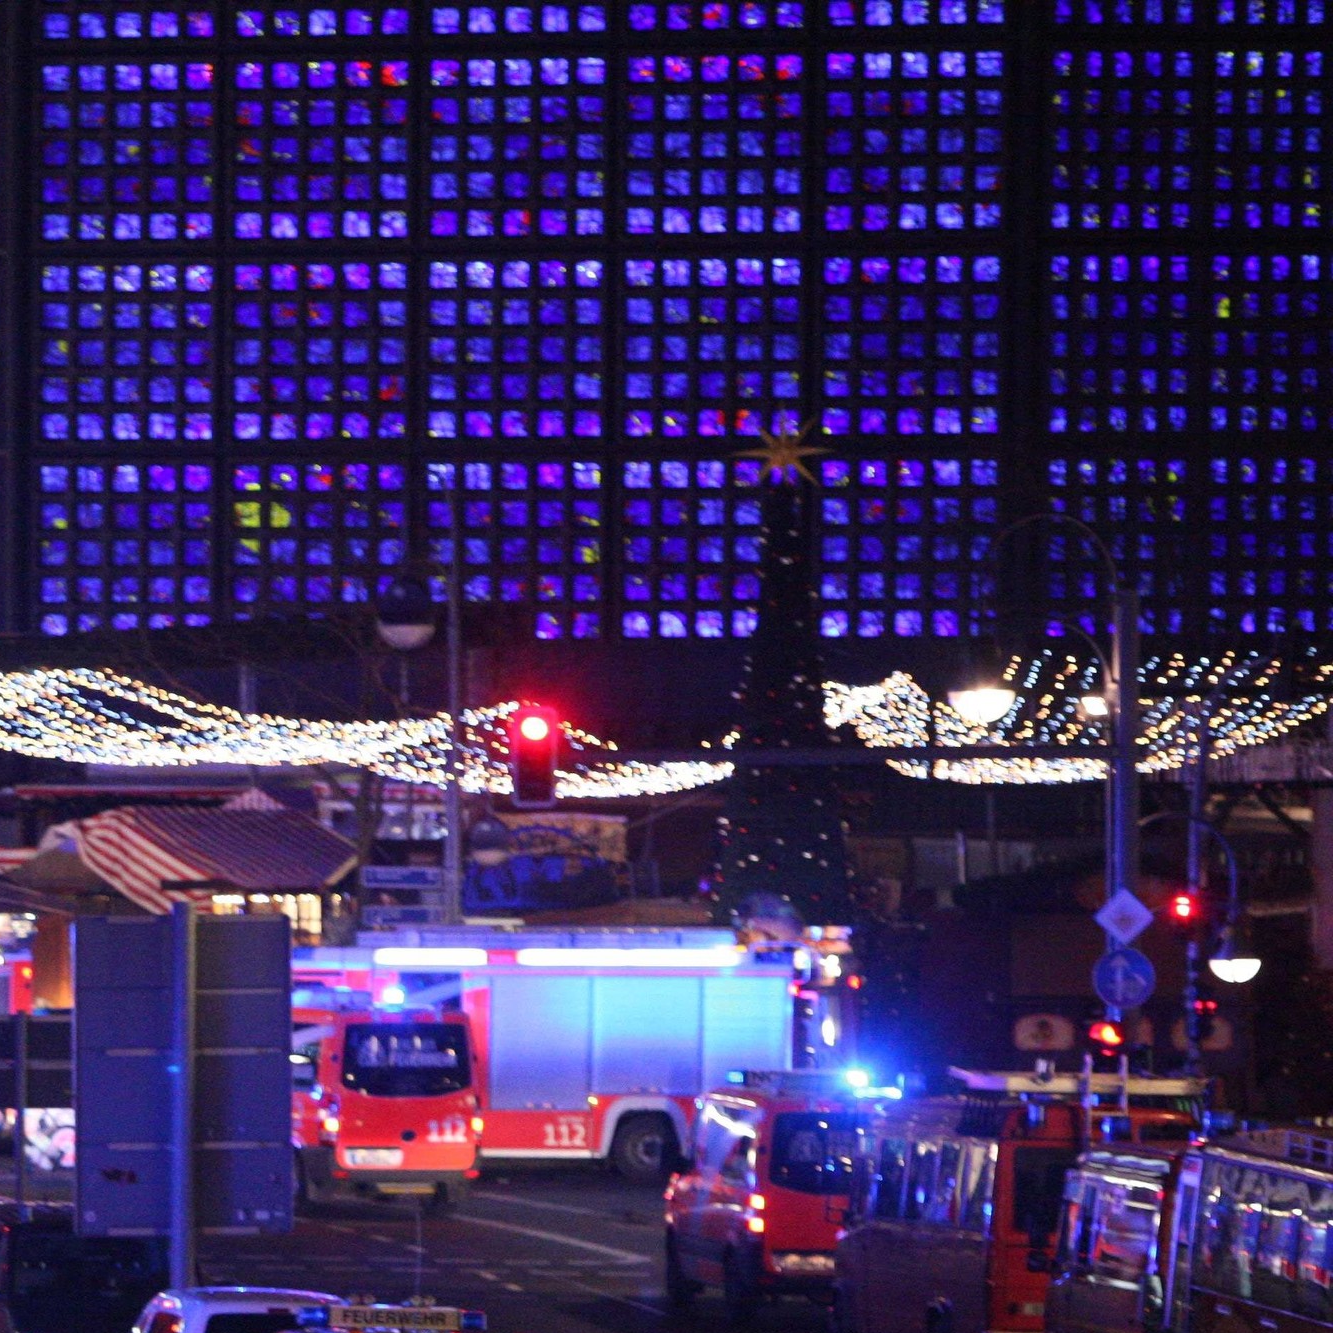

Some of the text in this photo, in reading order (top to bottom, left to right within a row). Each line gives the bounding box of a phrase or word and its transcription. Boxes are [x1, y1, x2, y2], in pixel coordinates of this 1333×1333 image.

[426, 1116, 467, 1143] 112
[543, 1122, 587, 1147] 112
[342, 1308, 447, 1327] FEUERWEHR
